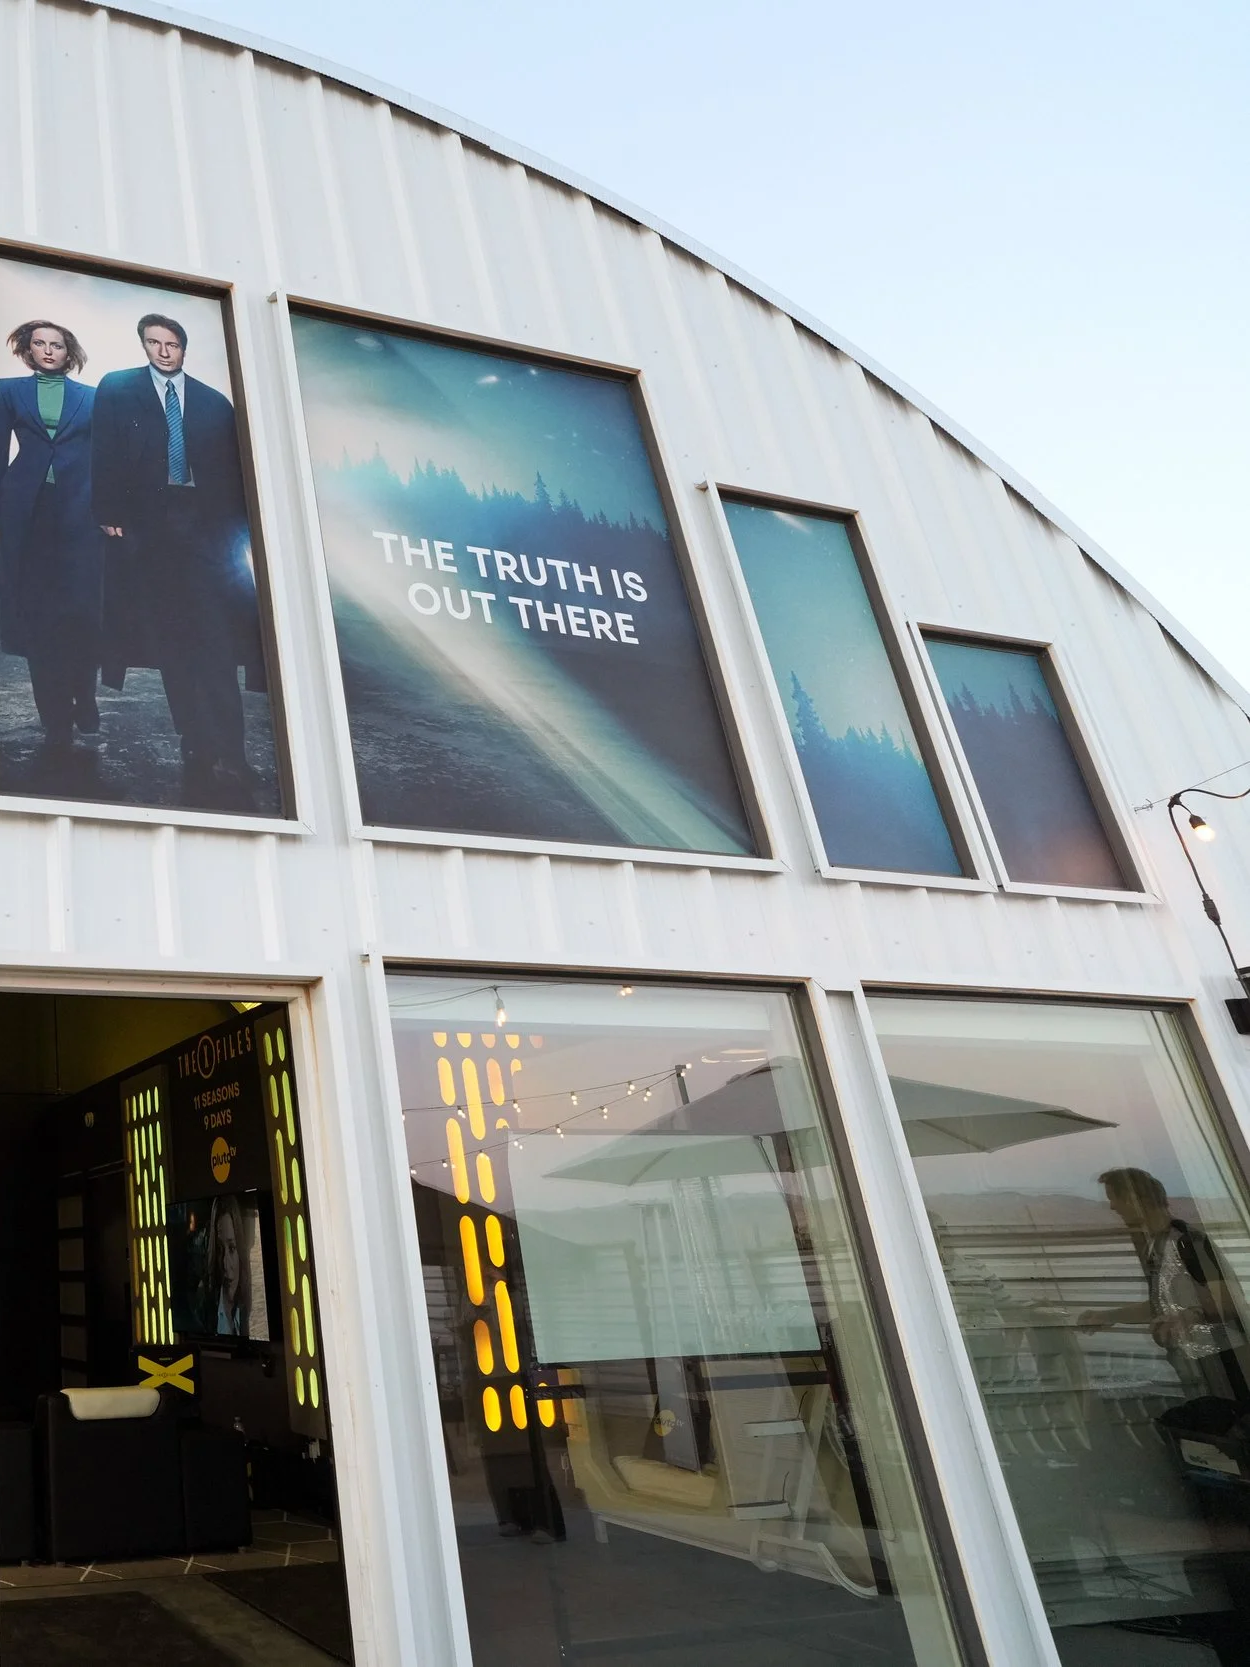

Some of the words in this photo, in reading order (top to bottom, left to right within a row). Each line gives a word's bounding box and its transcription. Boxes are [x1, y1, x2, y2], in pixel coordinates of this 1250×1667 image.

[372, 529, 458, 574] THE
[466, 545, 603, 596] TRUTH
[610, 569, 648, 602] IS
[408, 582, 496, 624] OUT
[508, 596, 640, 645] THERE
[178, 1050, 197, 1078] THE
[216, 1026, 251, 1064] FILES
[193, 1095, 200, 1110] 11
[201, 1081, 240, 1107] SEASONS
[204, 1115, 209, 1130] 9
[211, 1108, 232, 1129] DAYS
